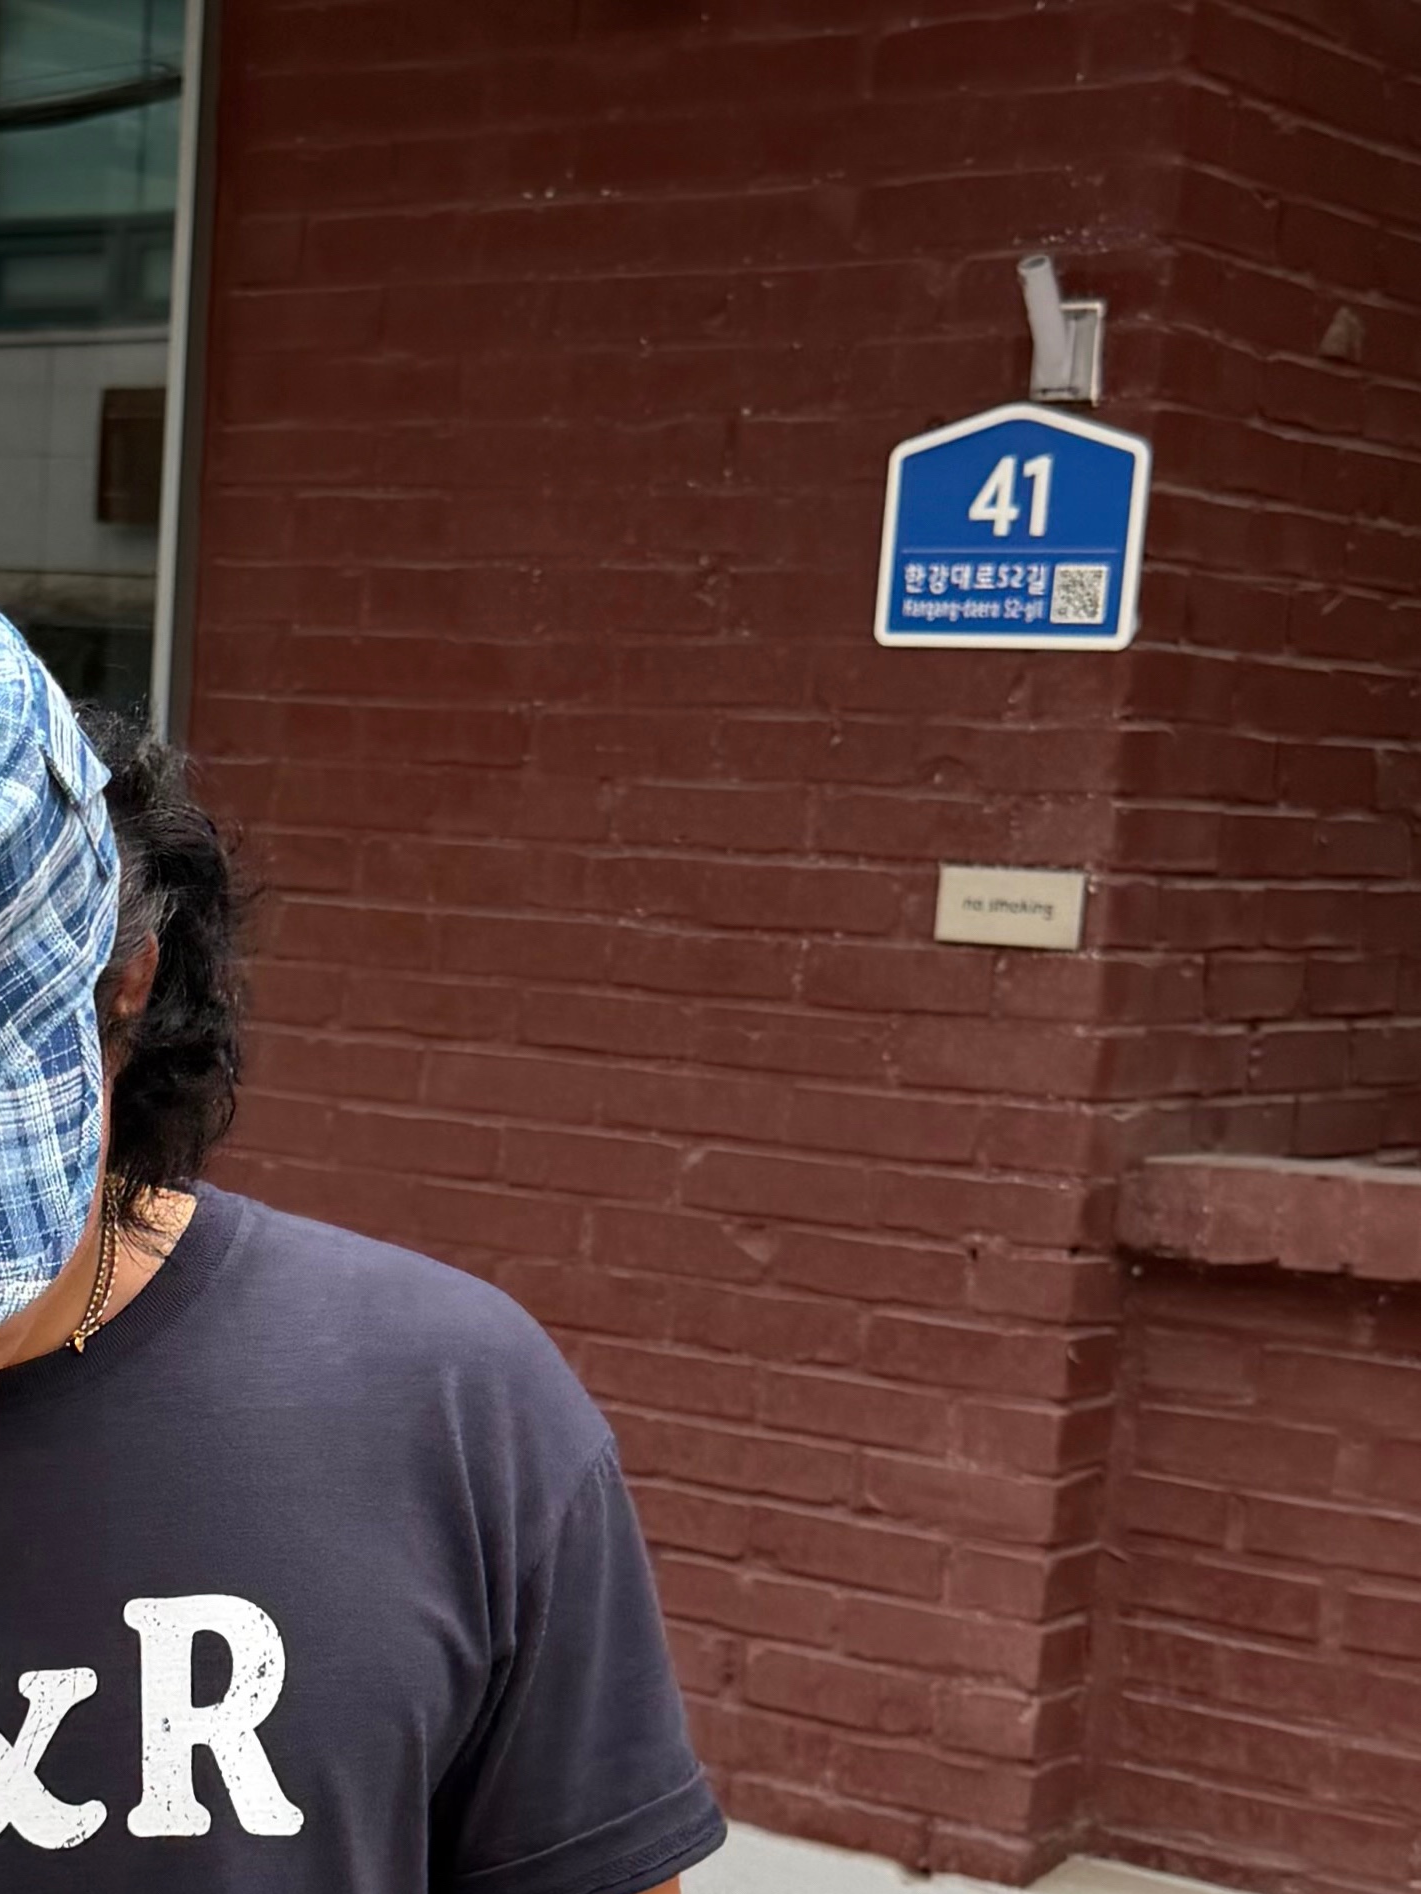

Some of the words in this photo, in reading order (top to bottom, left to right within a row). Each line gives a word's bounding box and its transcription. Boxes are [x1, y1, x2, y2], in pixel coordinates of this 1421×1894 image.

[967, 453, 1054, 537] 41
[904, 562, 1047, 596] 한강대로52길
[962, 897, 982, 913] no
[987, 898, 1055, 921] smoking
